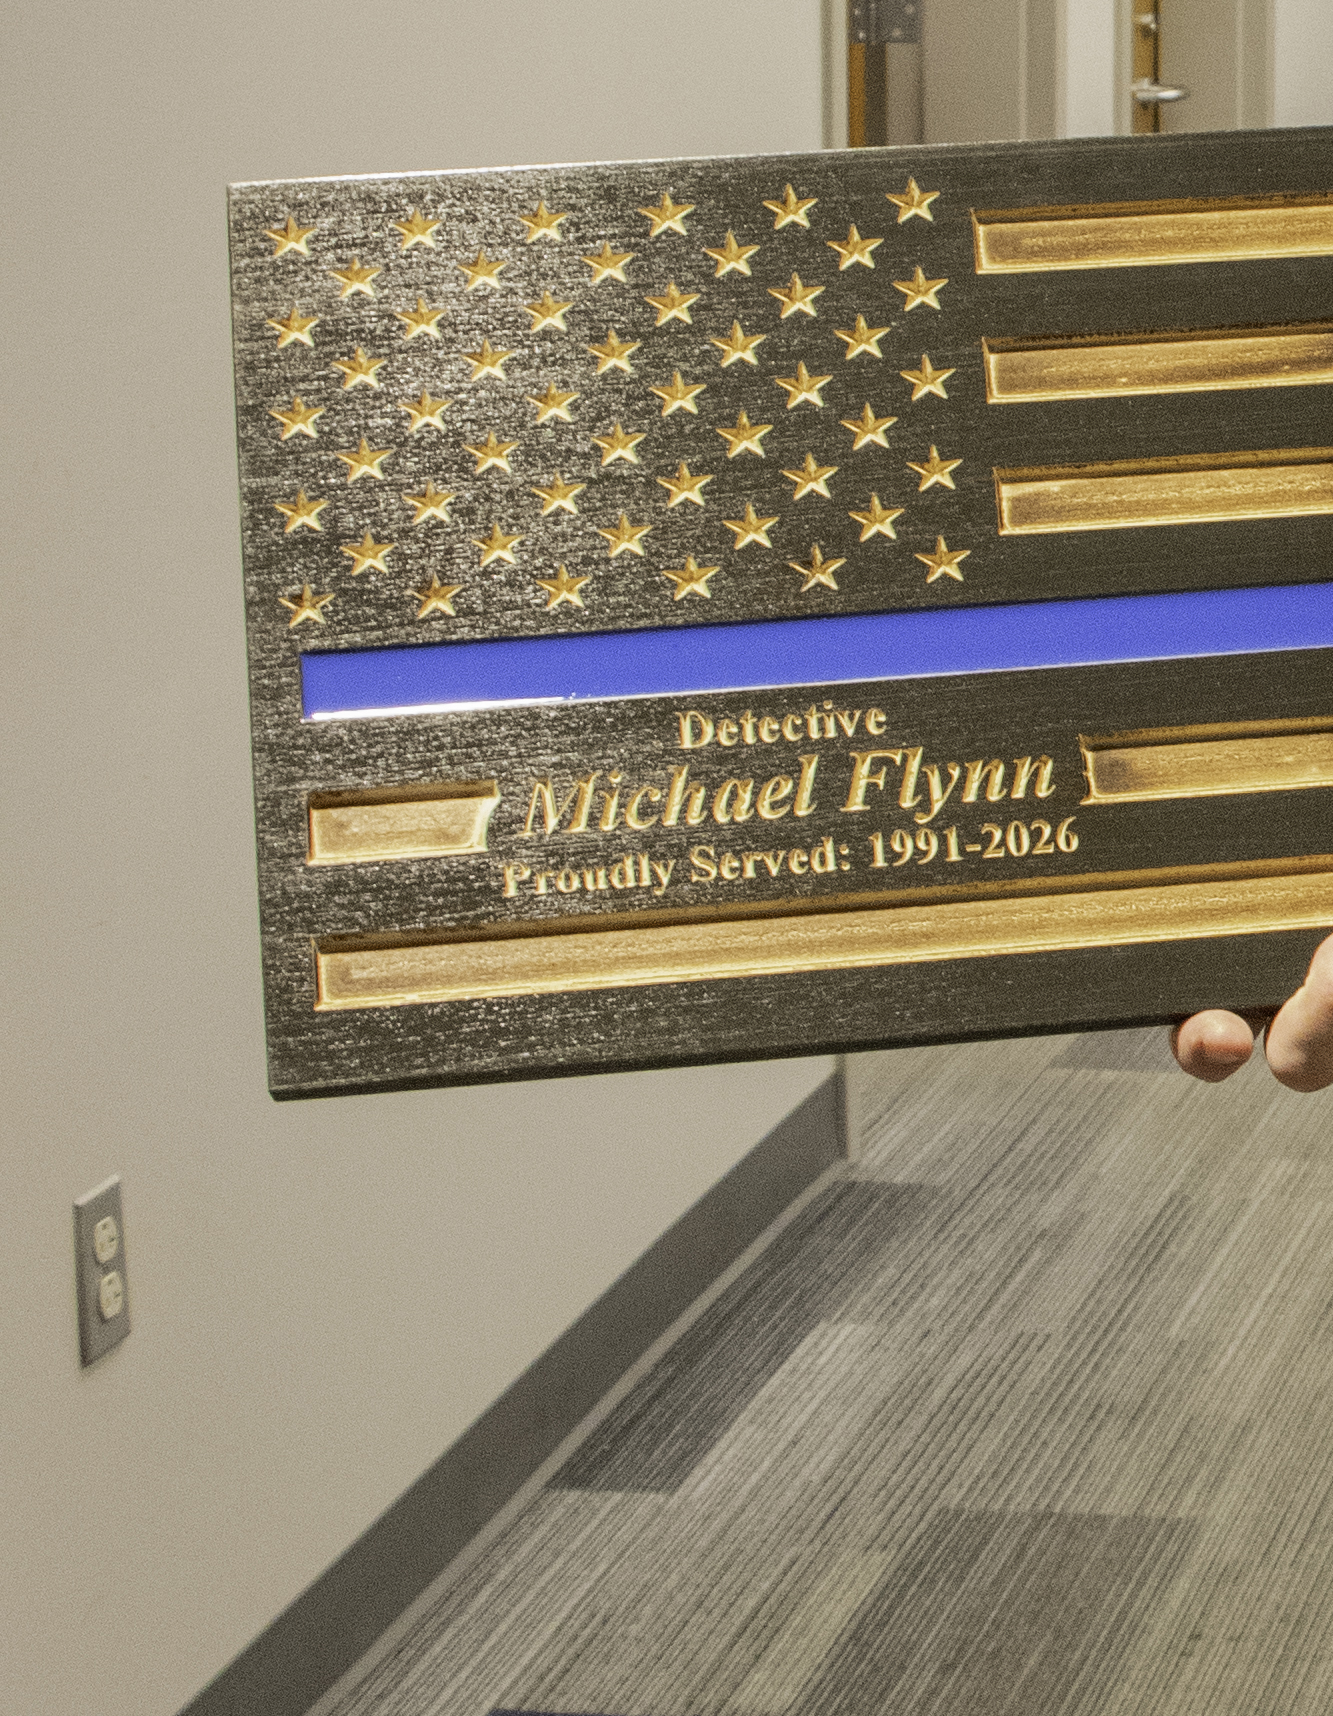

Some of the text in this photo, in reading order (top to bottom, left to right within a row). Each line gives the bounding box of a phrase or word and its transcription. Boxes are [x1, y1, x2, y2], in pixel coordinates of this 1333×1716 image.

[675, 699, 888, 750] Detective
[517, 746, 1057, 835] Michael Flynn
[501, 816, 1080, 898] Proudly Served: 1991-2026
